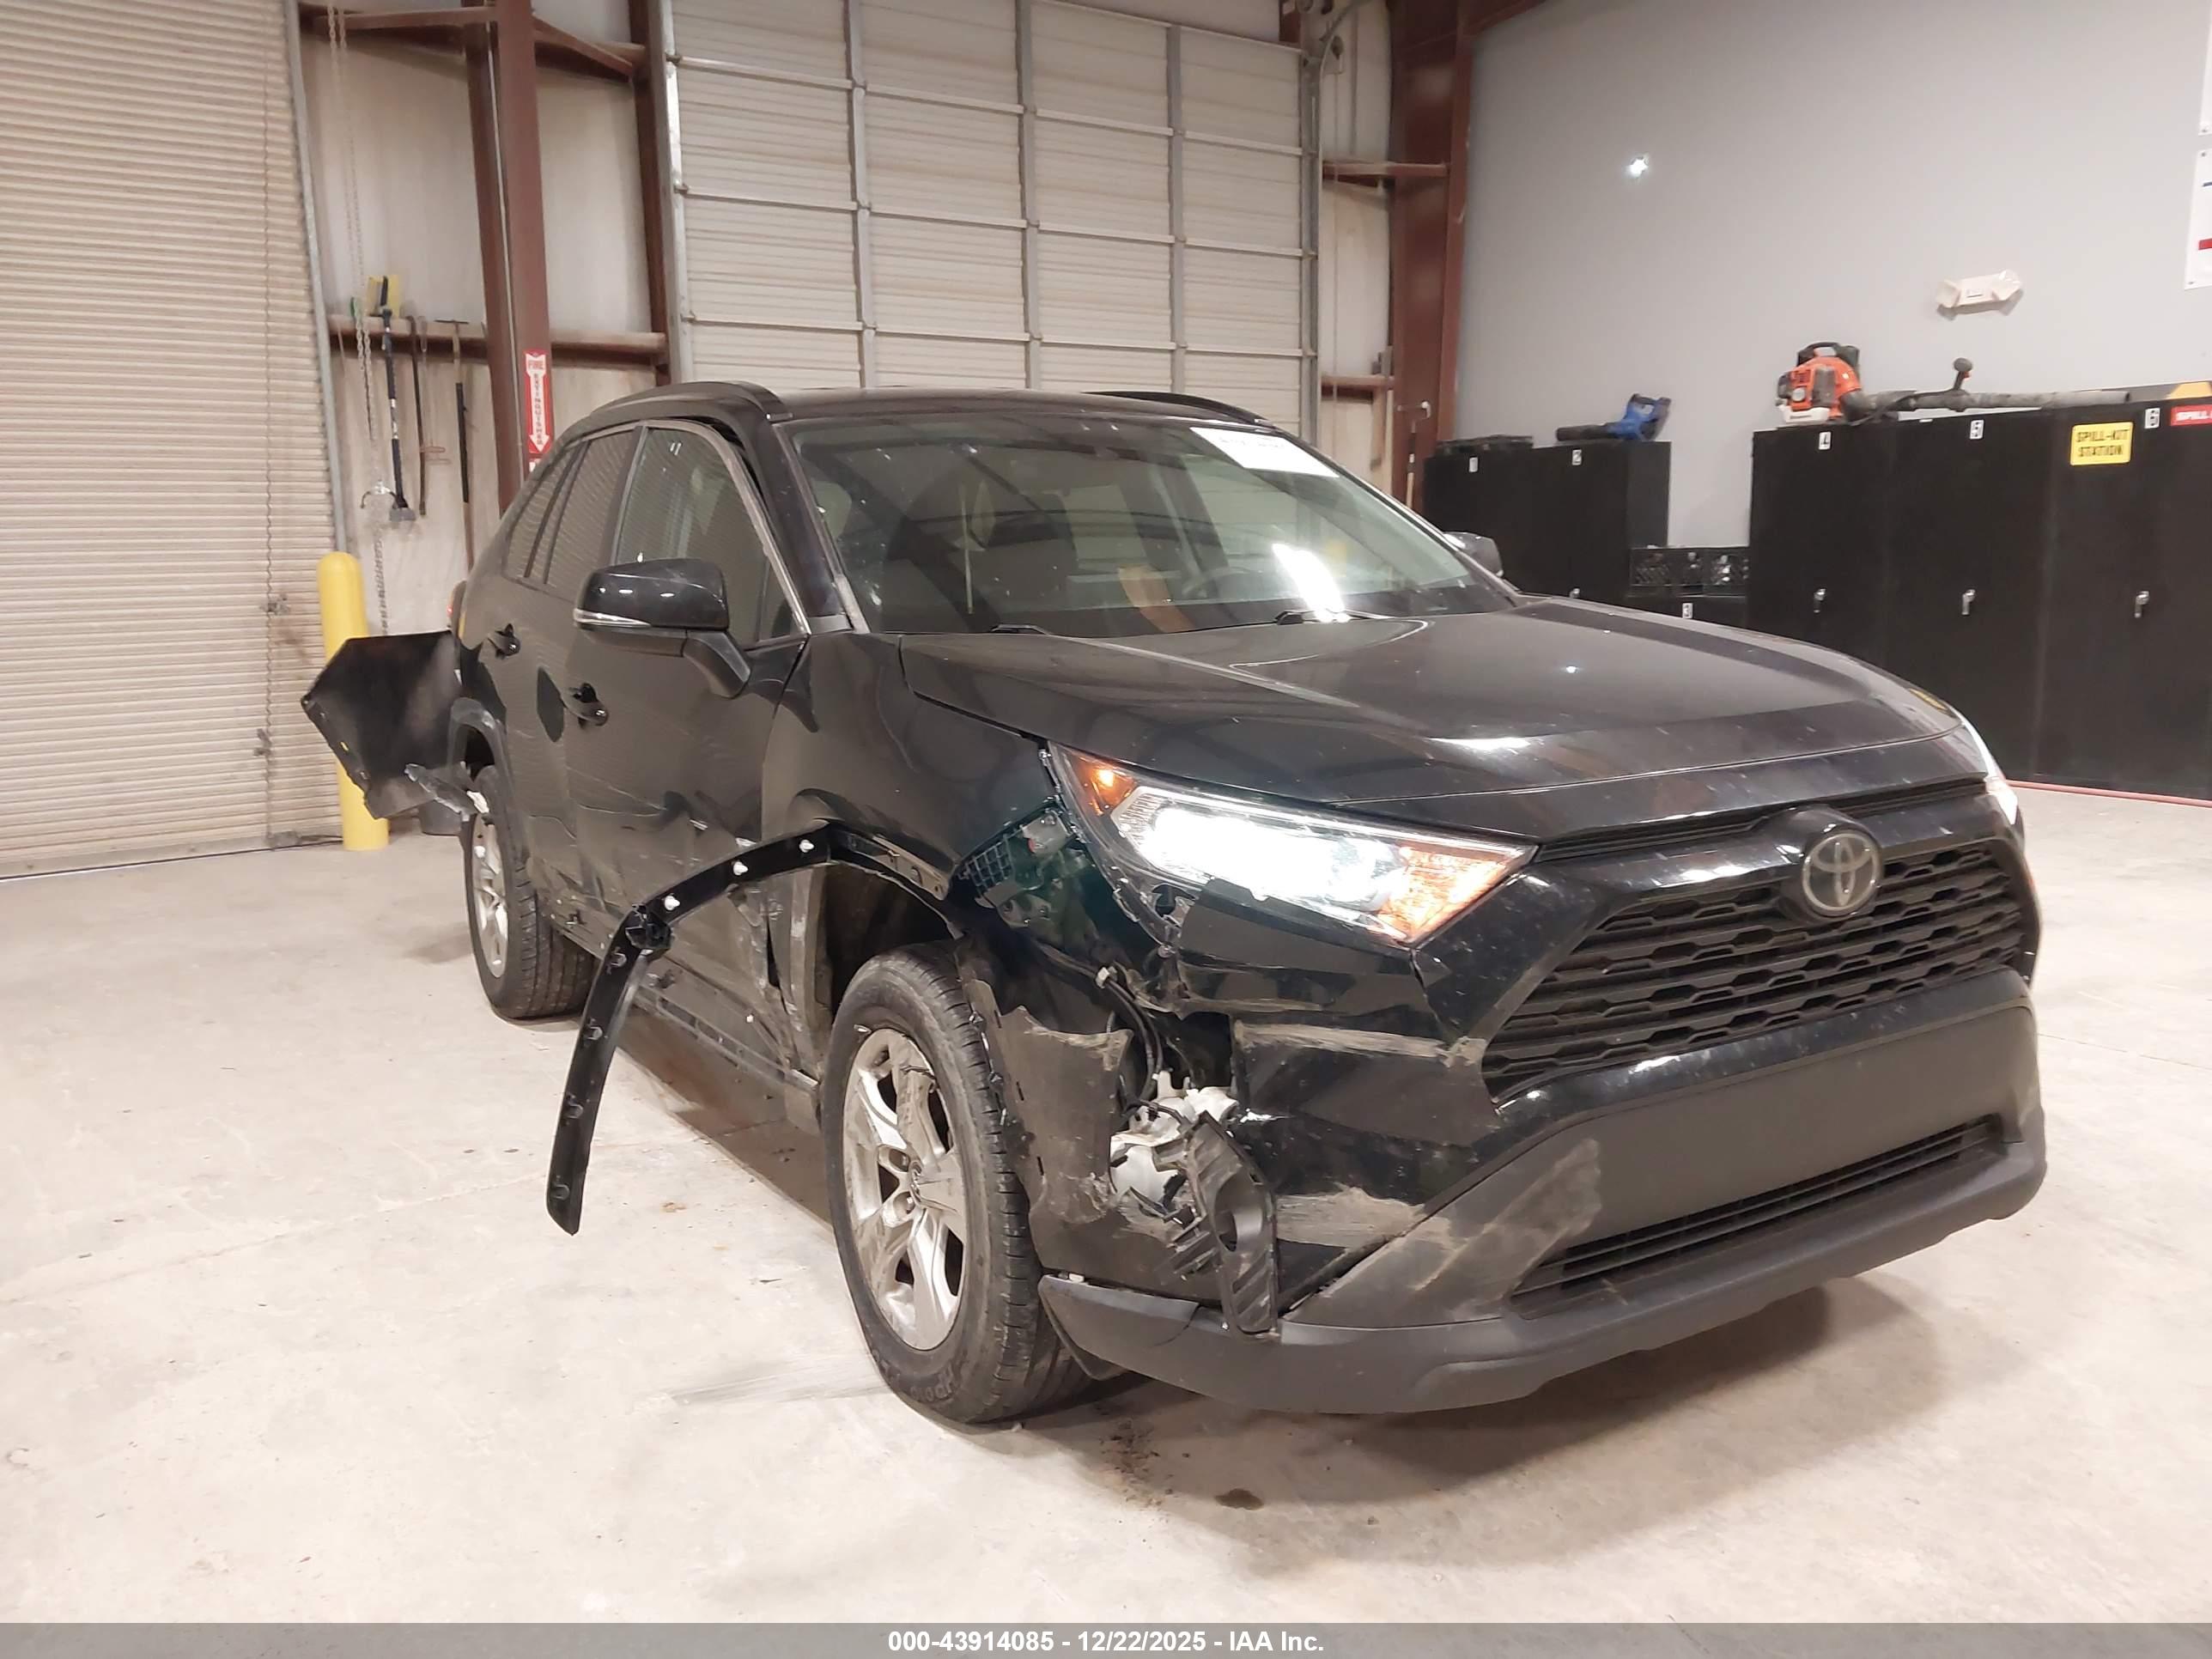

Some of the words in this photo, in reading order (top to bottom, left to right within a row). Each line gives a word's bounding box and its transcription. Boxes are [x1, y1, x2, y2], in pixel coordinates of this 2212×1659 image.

[528, 360, 544, 370] FIRE
[2076, 429, 2130, 442] SPILL-KIT
[2078, 445, 2123, 457] STATION
